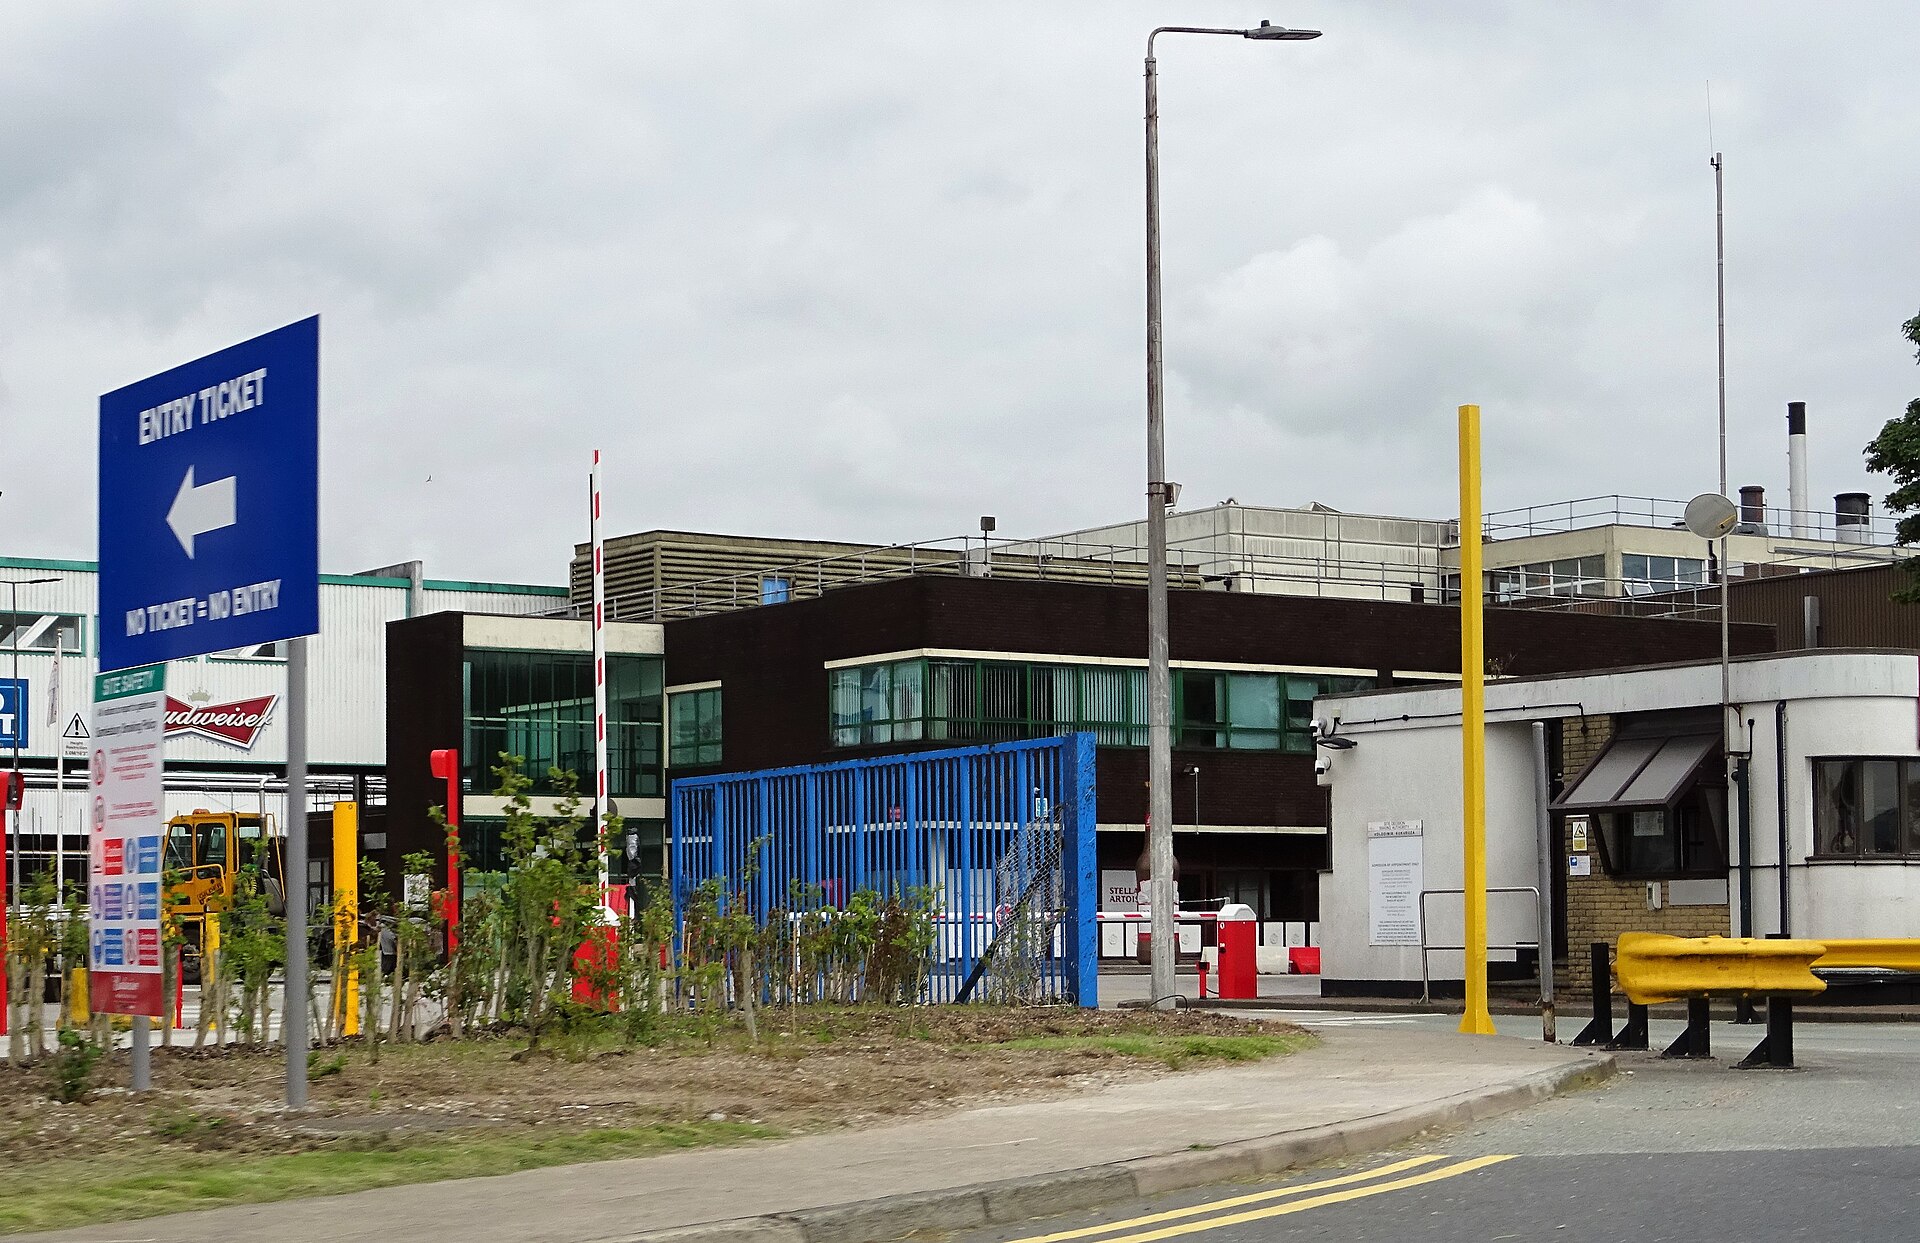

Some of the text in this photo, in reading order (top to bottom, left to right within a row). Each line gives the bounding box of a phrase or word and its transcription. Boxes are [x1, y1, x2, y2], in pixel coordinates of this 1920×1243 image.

[139, 367, 268, 446] ENTRY TICKET
[126, 606, 146, 637] NO
[147, 597, 196, 634] TICKET
[208, 590, 231, 621] NO
[231, 578, 282, 617] ENTRY
[163, 705, 273, 729] udweiser
